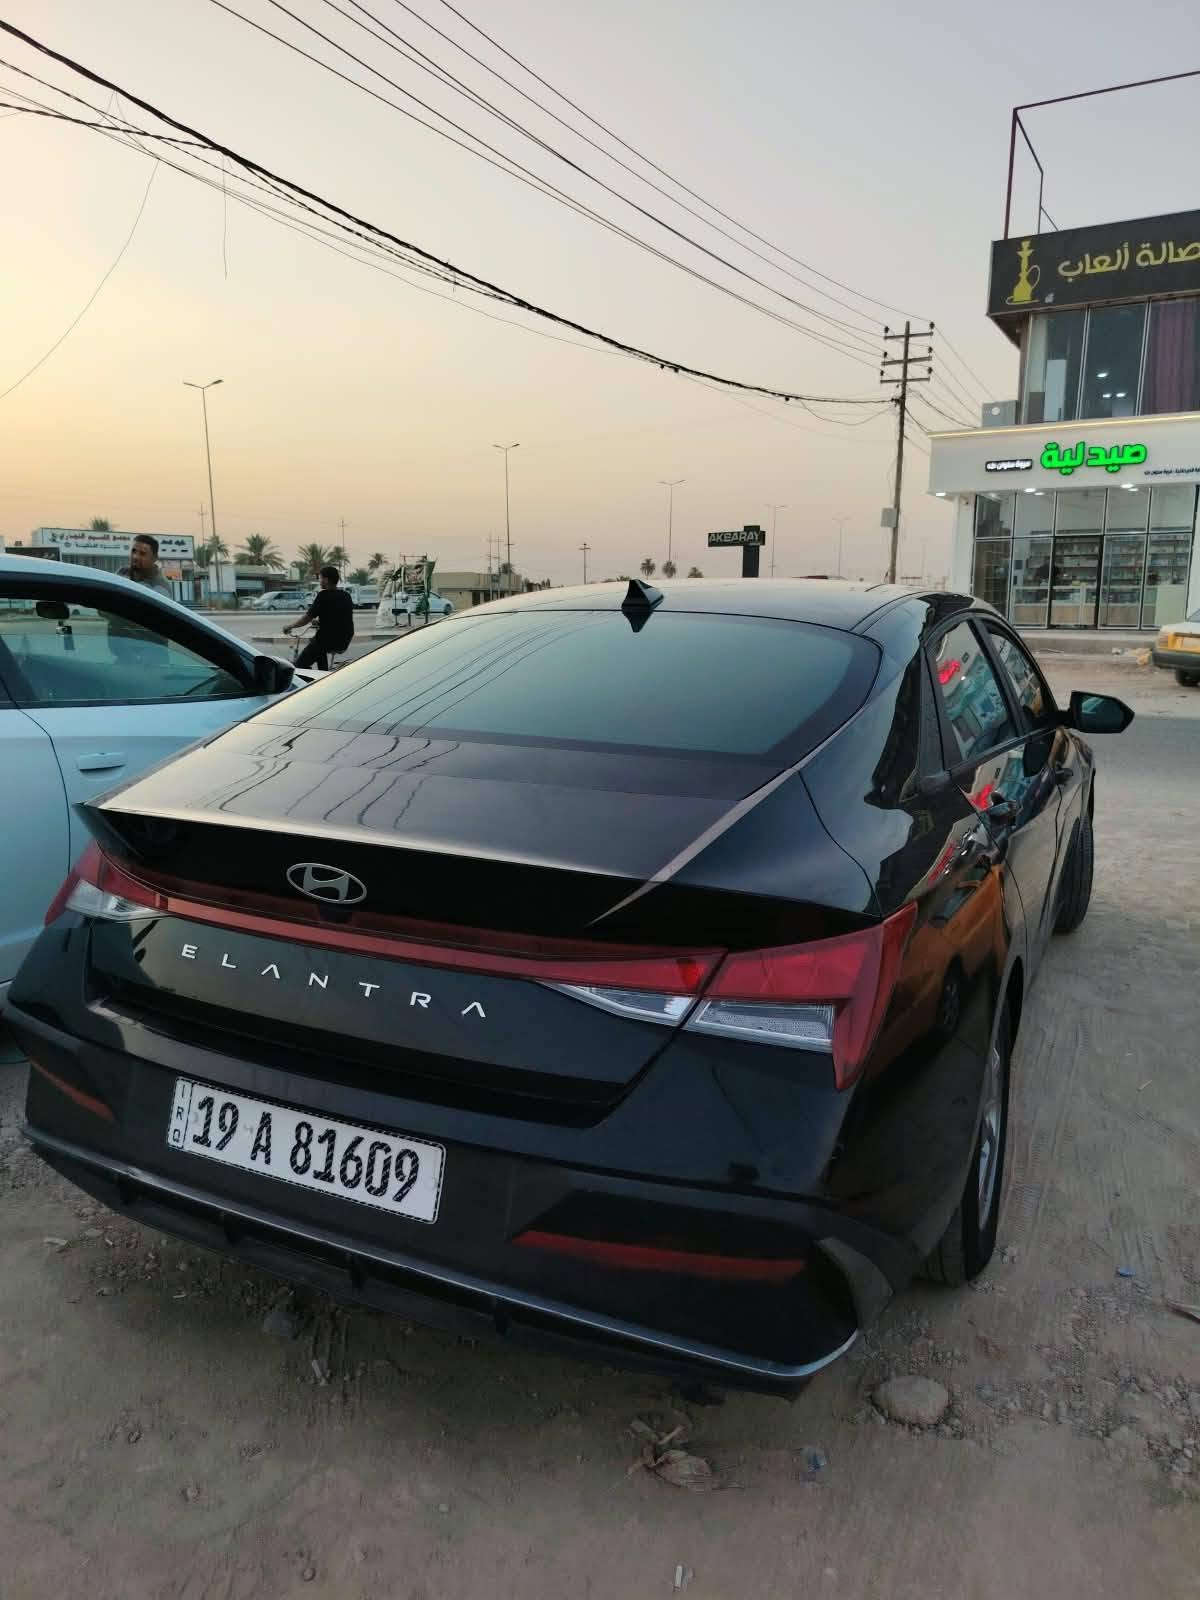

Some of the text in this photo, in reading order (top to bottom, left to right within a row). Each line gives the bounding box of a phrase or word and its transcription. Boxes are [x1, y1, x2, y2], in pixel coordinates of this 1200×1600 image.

[1058, 241, 1200, 283] صالة ألعاب
[1040, 441, 1148, 475] صيدلية
[180, 943, 487, 1018] ELANTRA
[171, 1083, 187, 1143] IRQ
[192, 1095, 420, 1203] 19 A 81609
